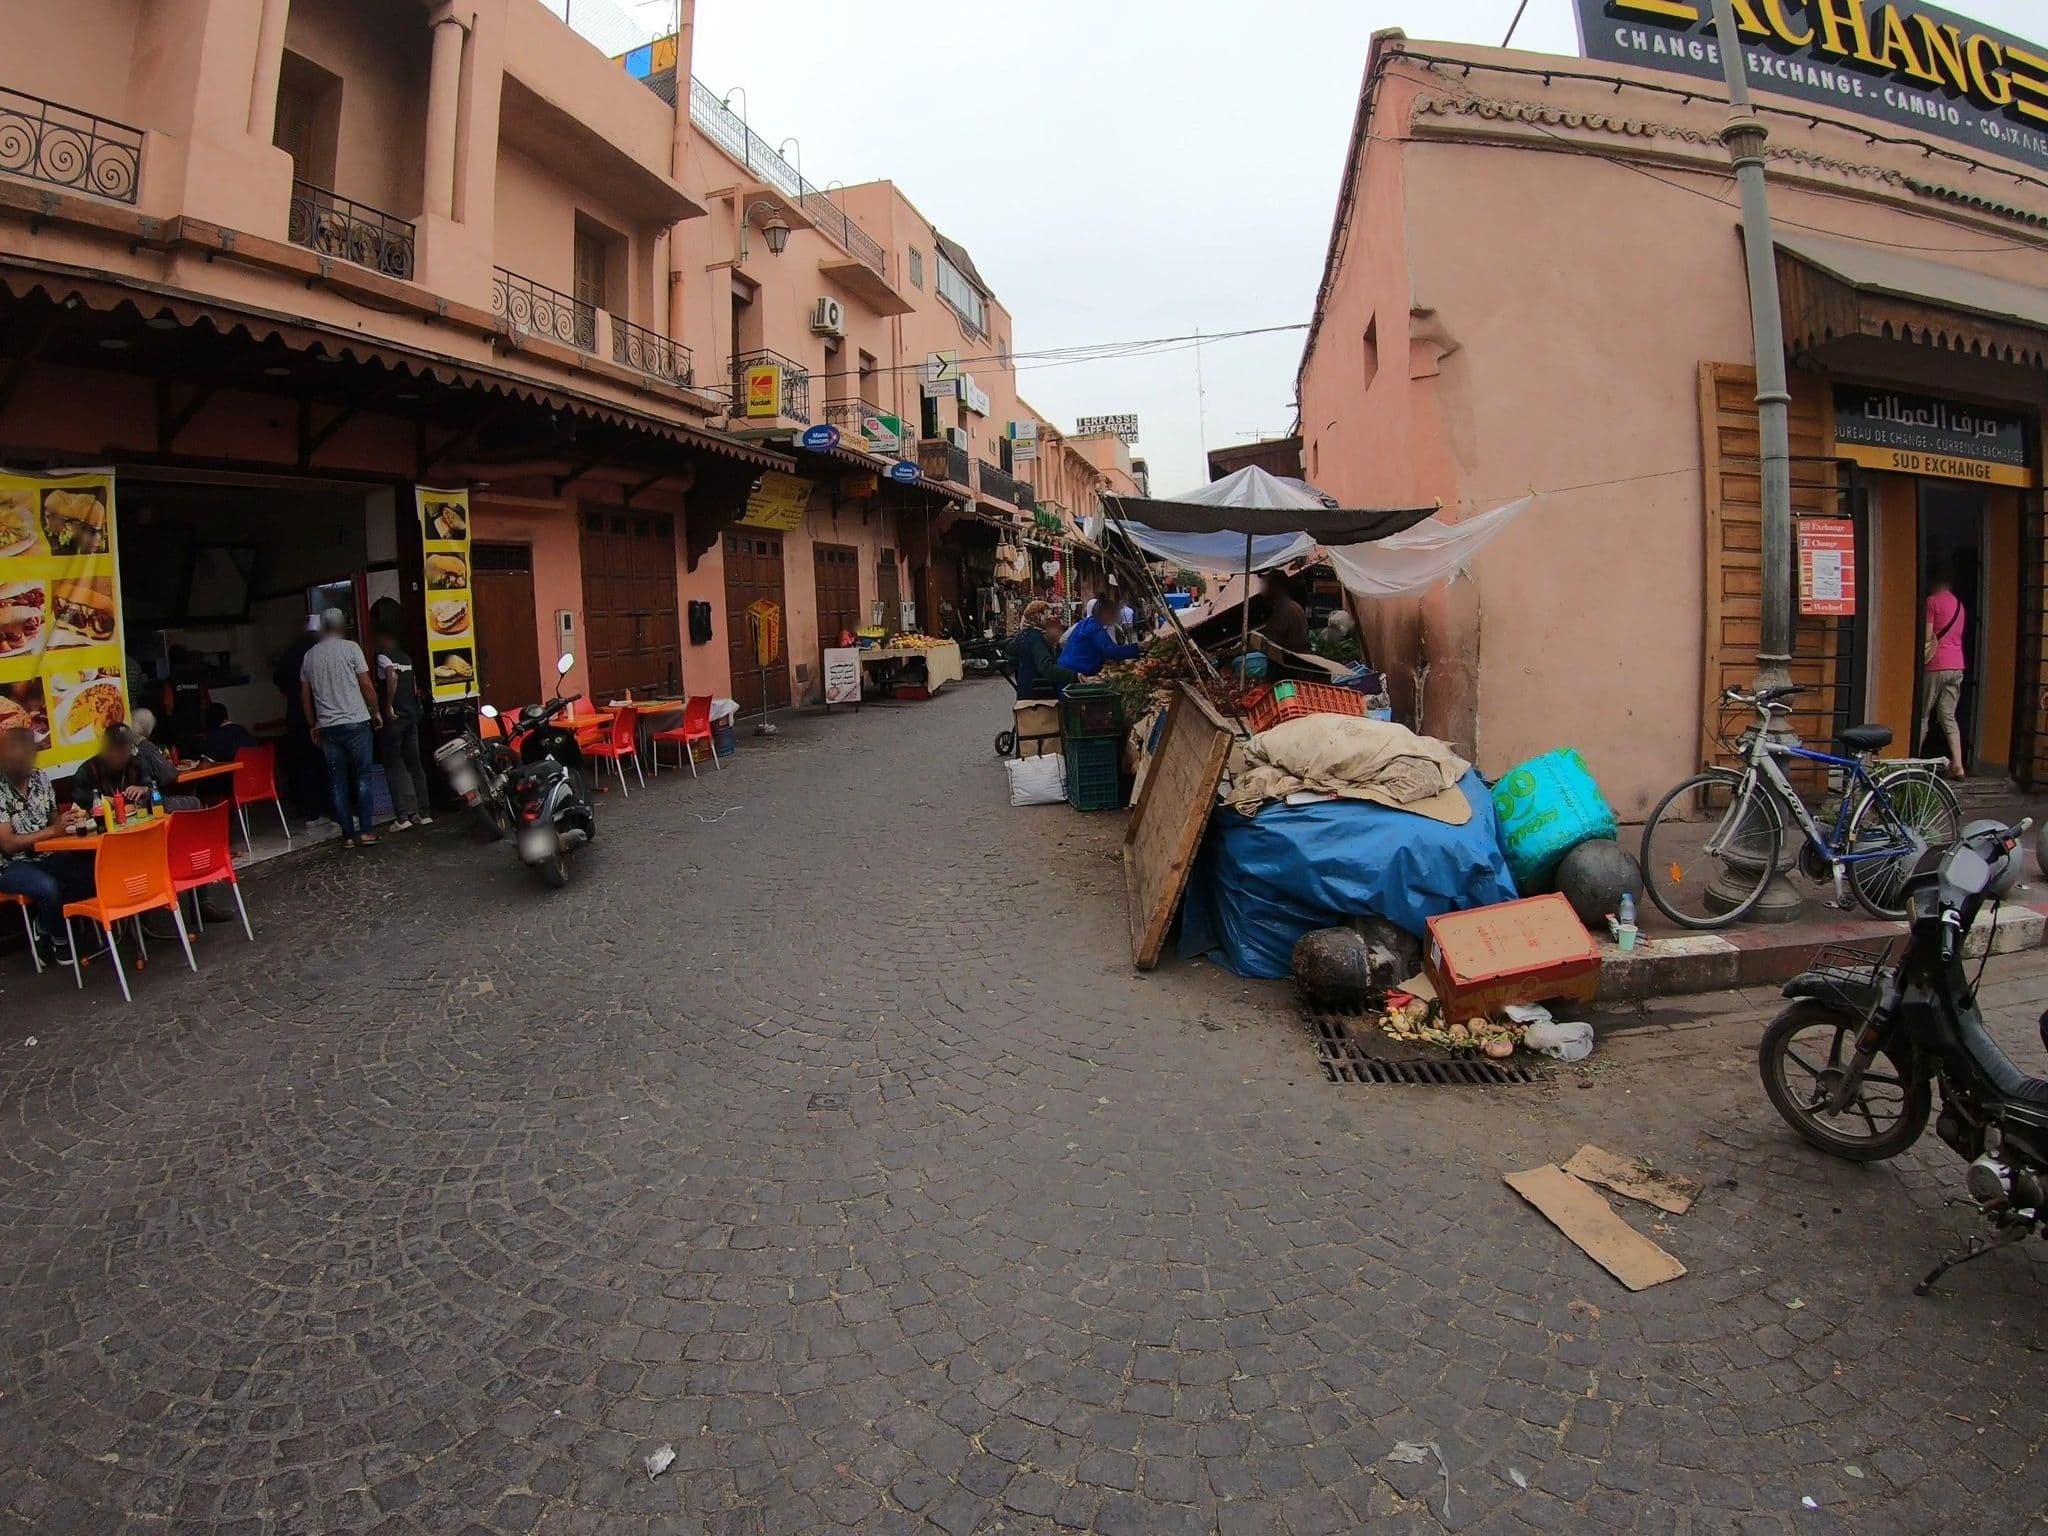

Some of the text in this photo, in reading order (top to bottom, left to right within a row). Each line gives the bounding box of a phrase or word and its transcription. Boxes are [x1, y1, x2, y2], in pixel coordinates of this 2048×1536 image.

[1615, 28, 1719, 64] CHANGE
[1747, 52, 1863, 98] EXCHANGE
[1883, 87, 1960, 126] CAMBIO
[751, 399, 772, 407] Kodak
[1077, 414, 1138, 426] TERRASSE
[1105, 422, 1138, 434] SNACK
[1834, 424, 1871, 441] BUREAU
[1875, 430, 1887, 443] DE
[1890, 431, 1927, 448] CHANGE
[1893, 452, 1992, 480] SUD EXCHANGE
